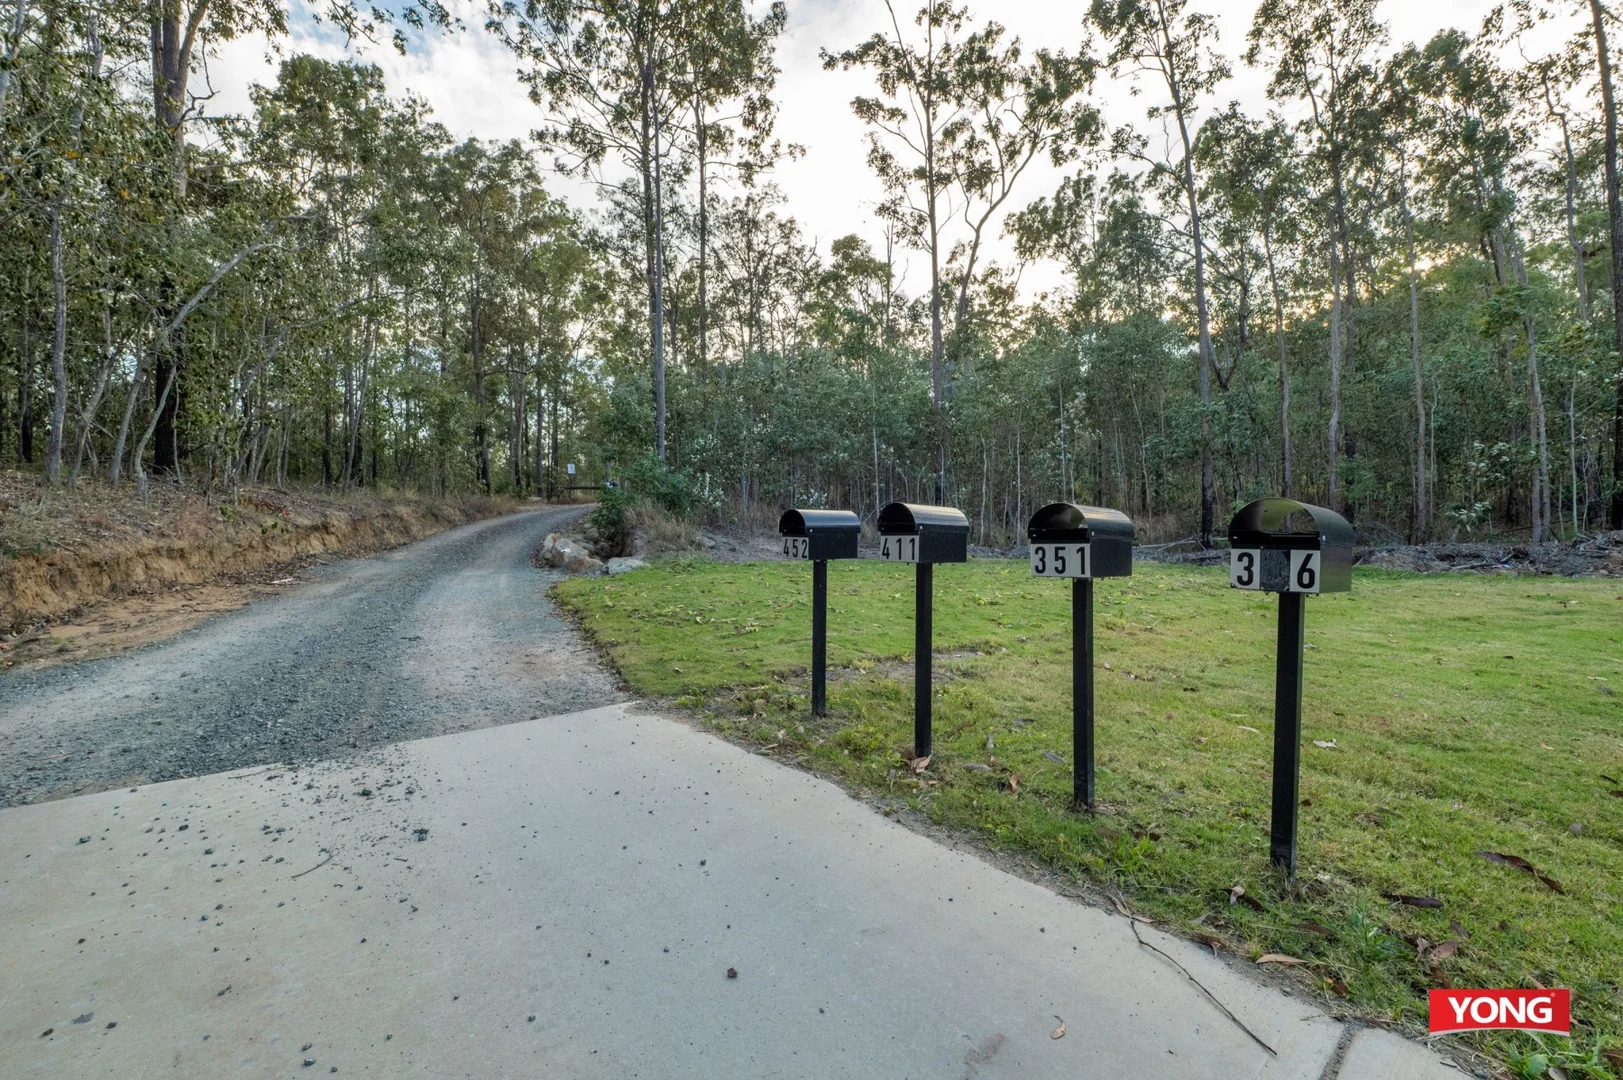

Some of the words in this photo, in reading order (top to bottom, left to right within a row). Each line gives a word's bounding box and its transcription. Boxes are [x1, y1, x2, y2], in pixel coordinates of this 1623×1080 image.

[783, 539, 808, 559] 452
[882, 537, 916, 561] 411
[1034, 546, 1086, 575] 351
